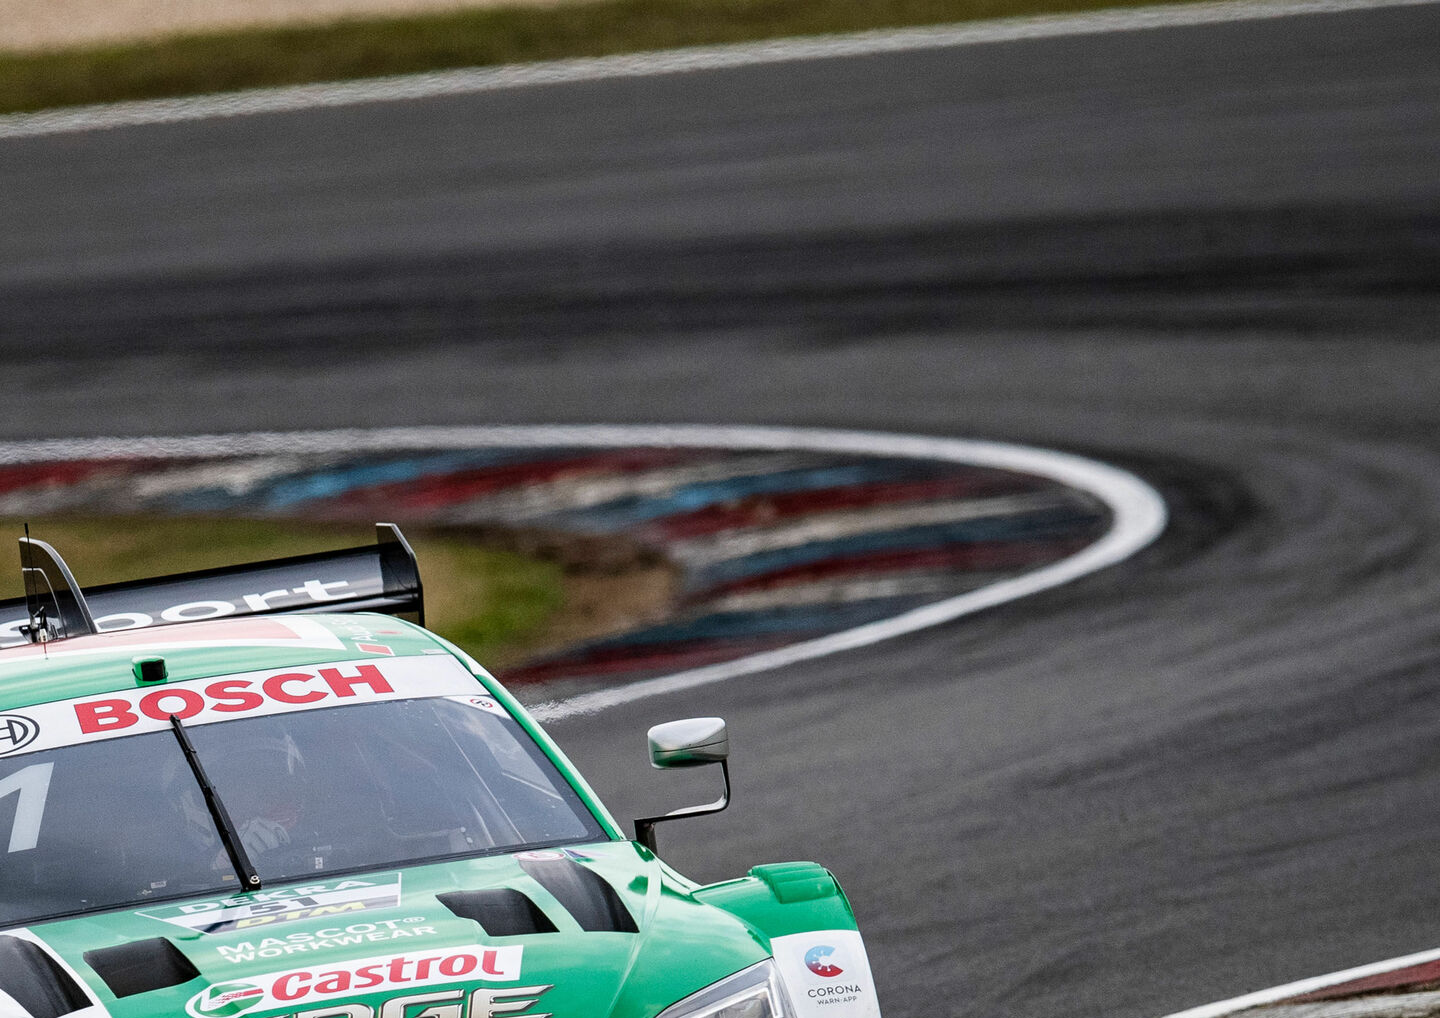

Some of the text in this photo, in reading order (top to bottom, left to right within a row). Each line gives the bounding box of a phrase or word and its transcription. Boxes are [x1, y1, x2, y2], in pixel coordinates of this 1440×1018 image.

[73, 664, 395, 734] BOSCH
[178, 880, 377, 914] DEKRA
[249, 896, 320, 916] 51
[236, 901, 366, 929] DTM
[224, 922, 437, 964] WORKWEAR
[271, 950, 505, 1001] Castrol
[808, 984, 862, 998] CORONA
